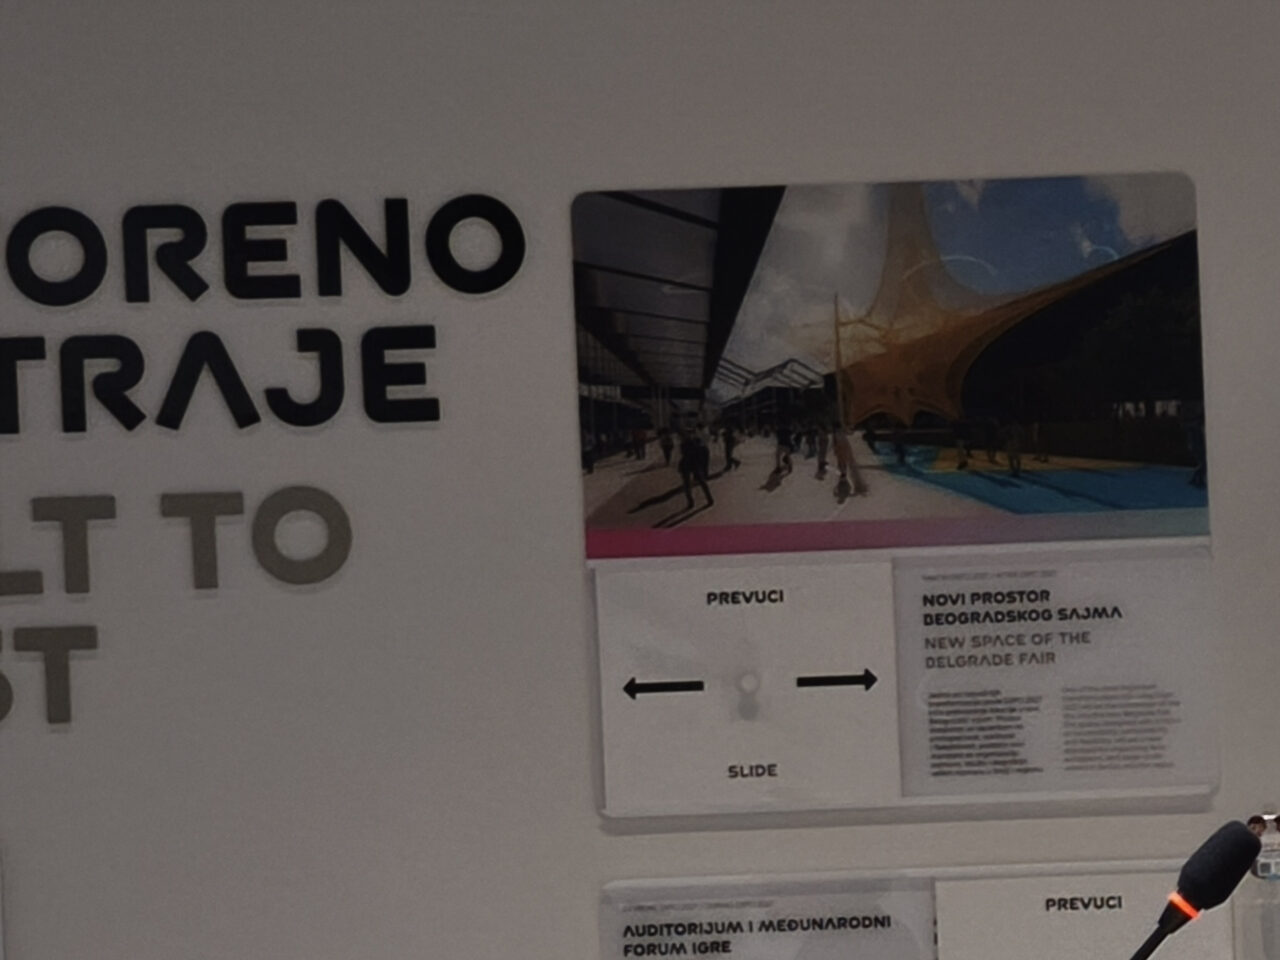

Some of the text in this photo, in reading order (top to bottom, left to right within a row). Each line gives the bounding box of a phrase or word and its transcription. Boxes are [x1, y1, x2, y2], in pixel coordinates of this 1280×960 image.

[5, 193, 526, 308] ORENO
[160, 485, 353, 590] TO
[706, 589, 785, 606] PREVUCI
[922, 589, 1051, 608] NOVI PROSTOR
[923, 606, 1123, 626] BEOGRADSKOG SAJMA
[924, 631, 1091, 650] NEW SPACE OF THE
[925, 651, 1056, 669] BELGRADE FAIR
[0, 625, 98, 726] T
[727, 763, 778, 779] SLIDE
[1045, 895, 1123, 912] PREVUCI
[623, 915, 892, 938] AUDITORIJUM I MEĐUNARODNI
[623, 940, 732, 957] FORUM IGRE
